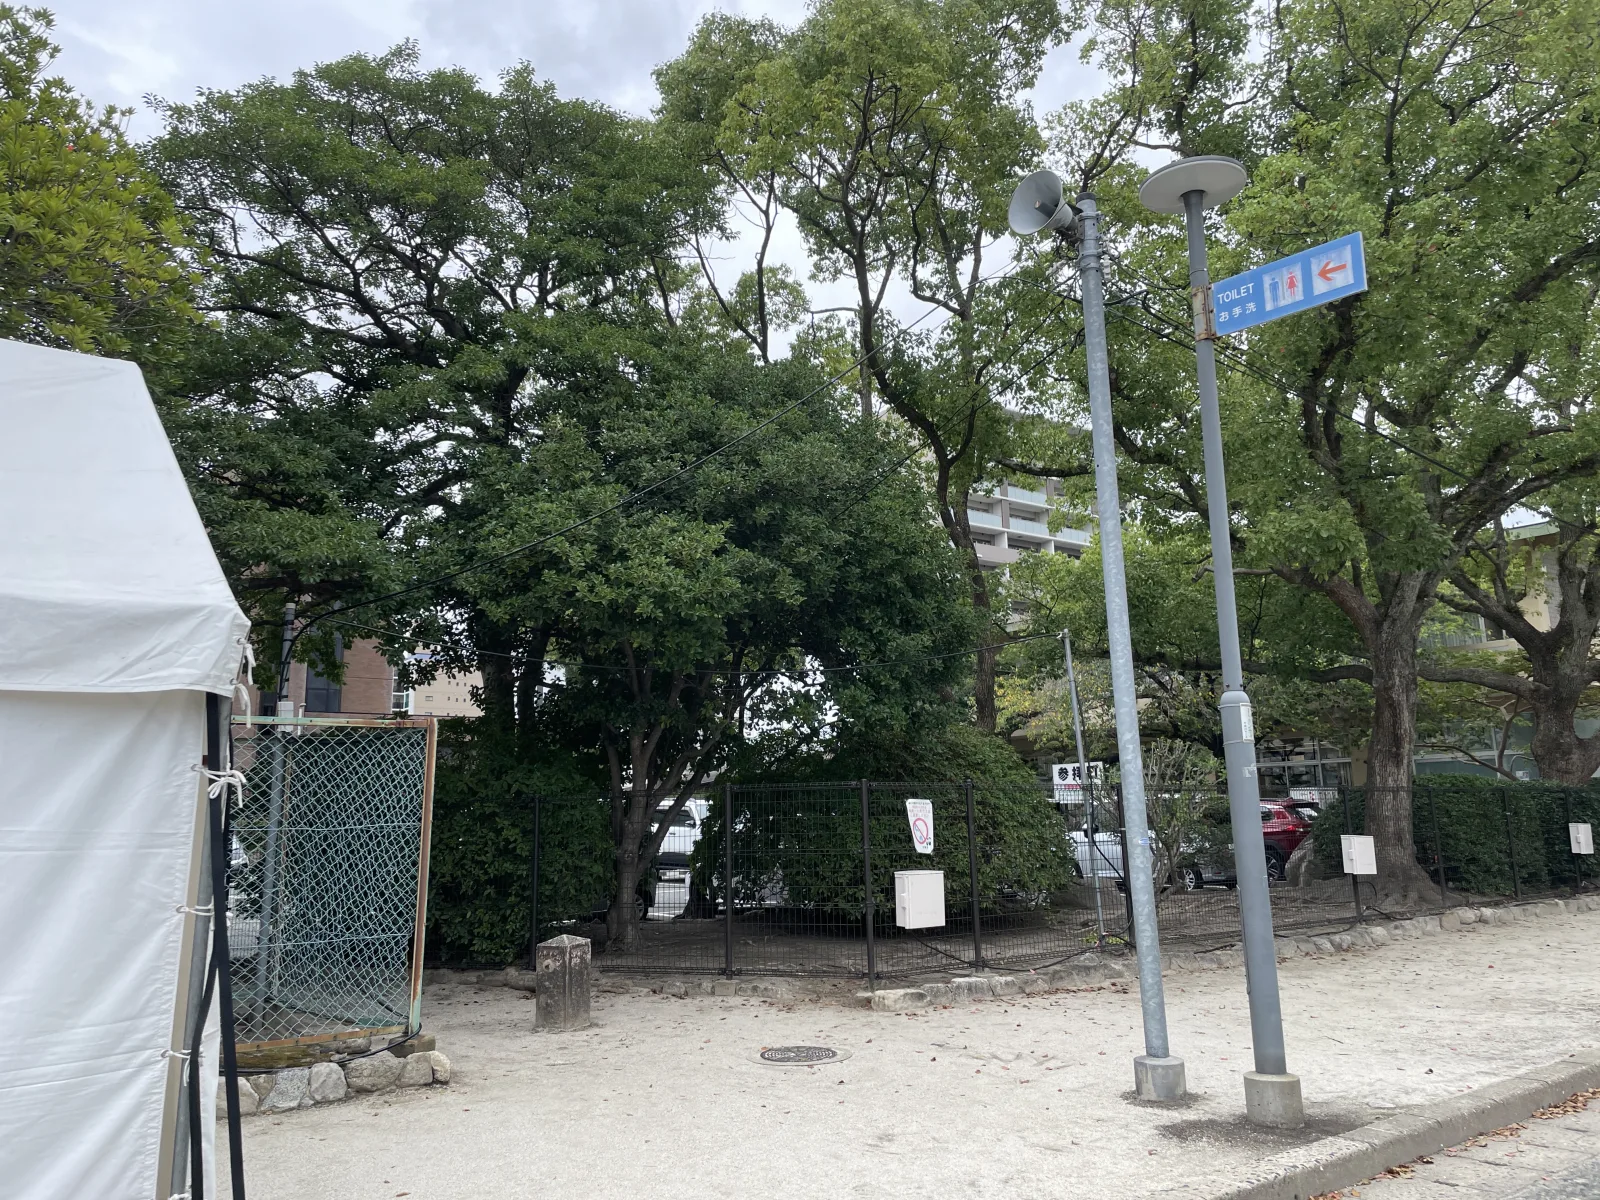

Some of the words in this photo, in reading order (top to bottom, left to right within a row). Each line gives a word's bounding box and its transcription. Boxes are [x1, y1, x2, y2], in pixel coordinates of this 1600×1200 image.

[1217, 282, 1255, 304] TOILET
[1219, 302, 1257, 322] お手洗
